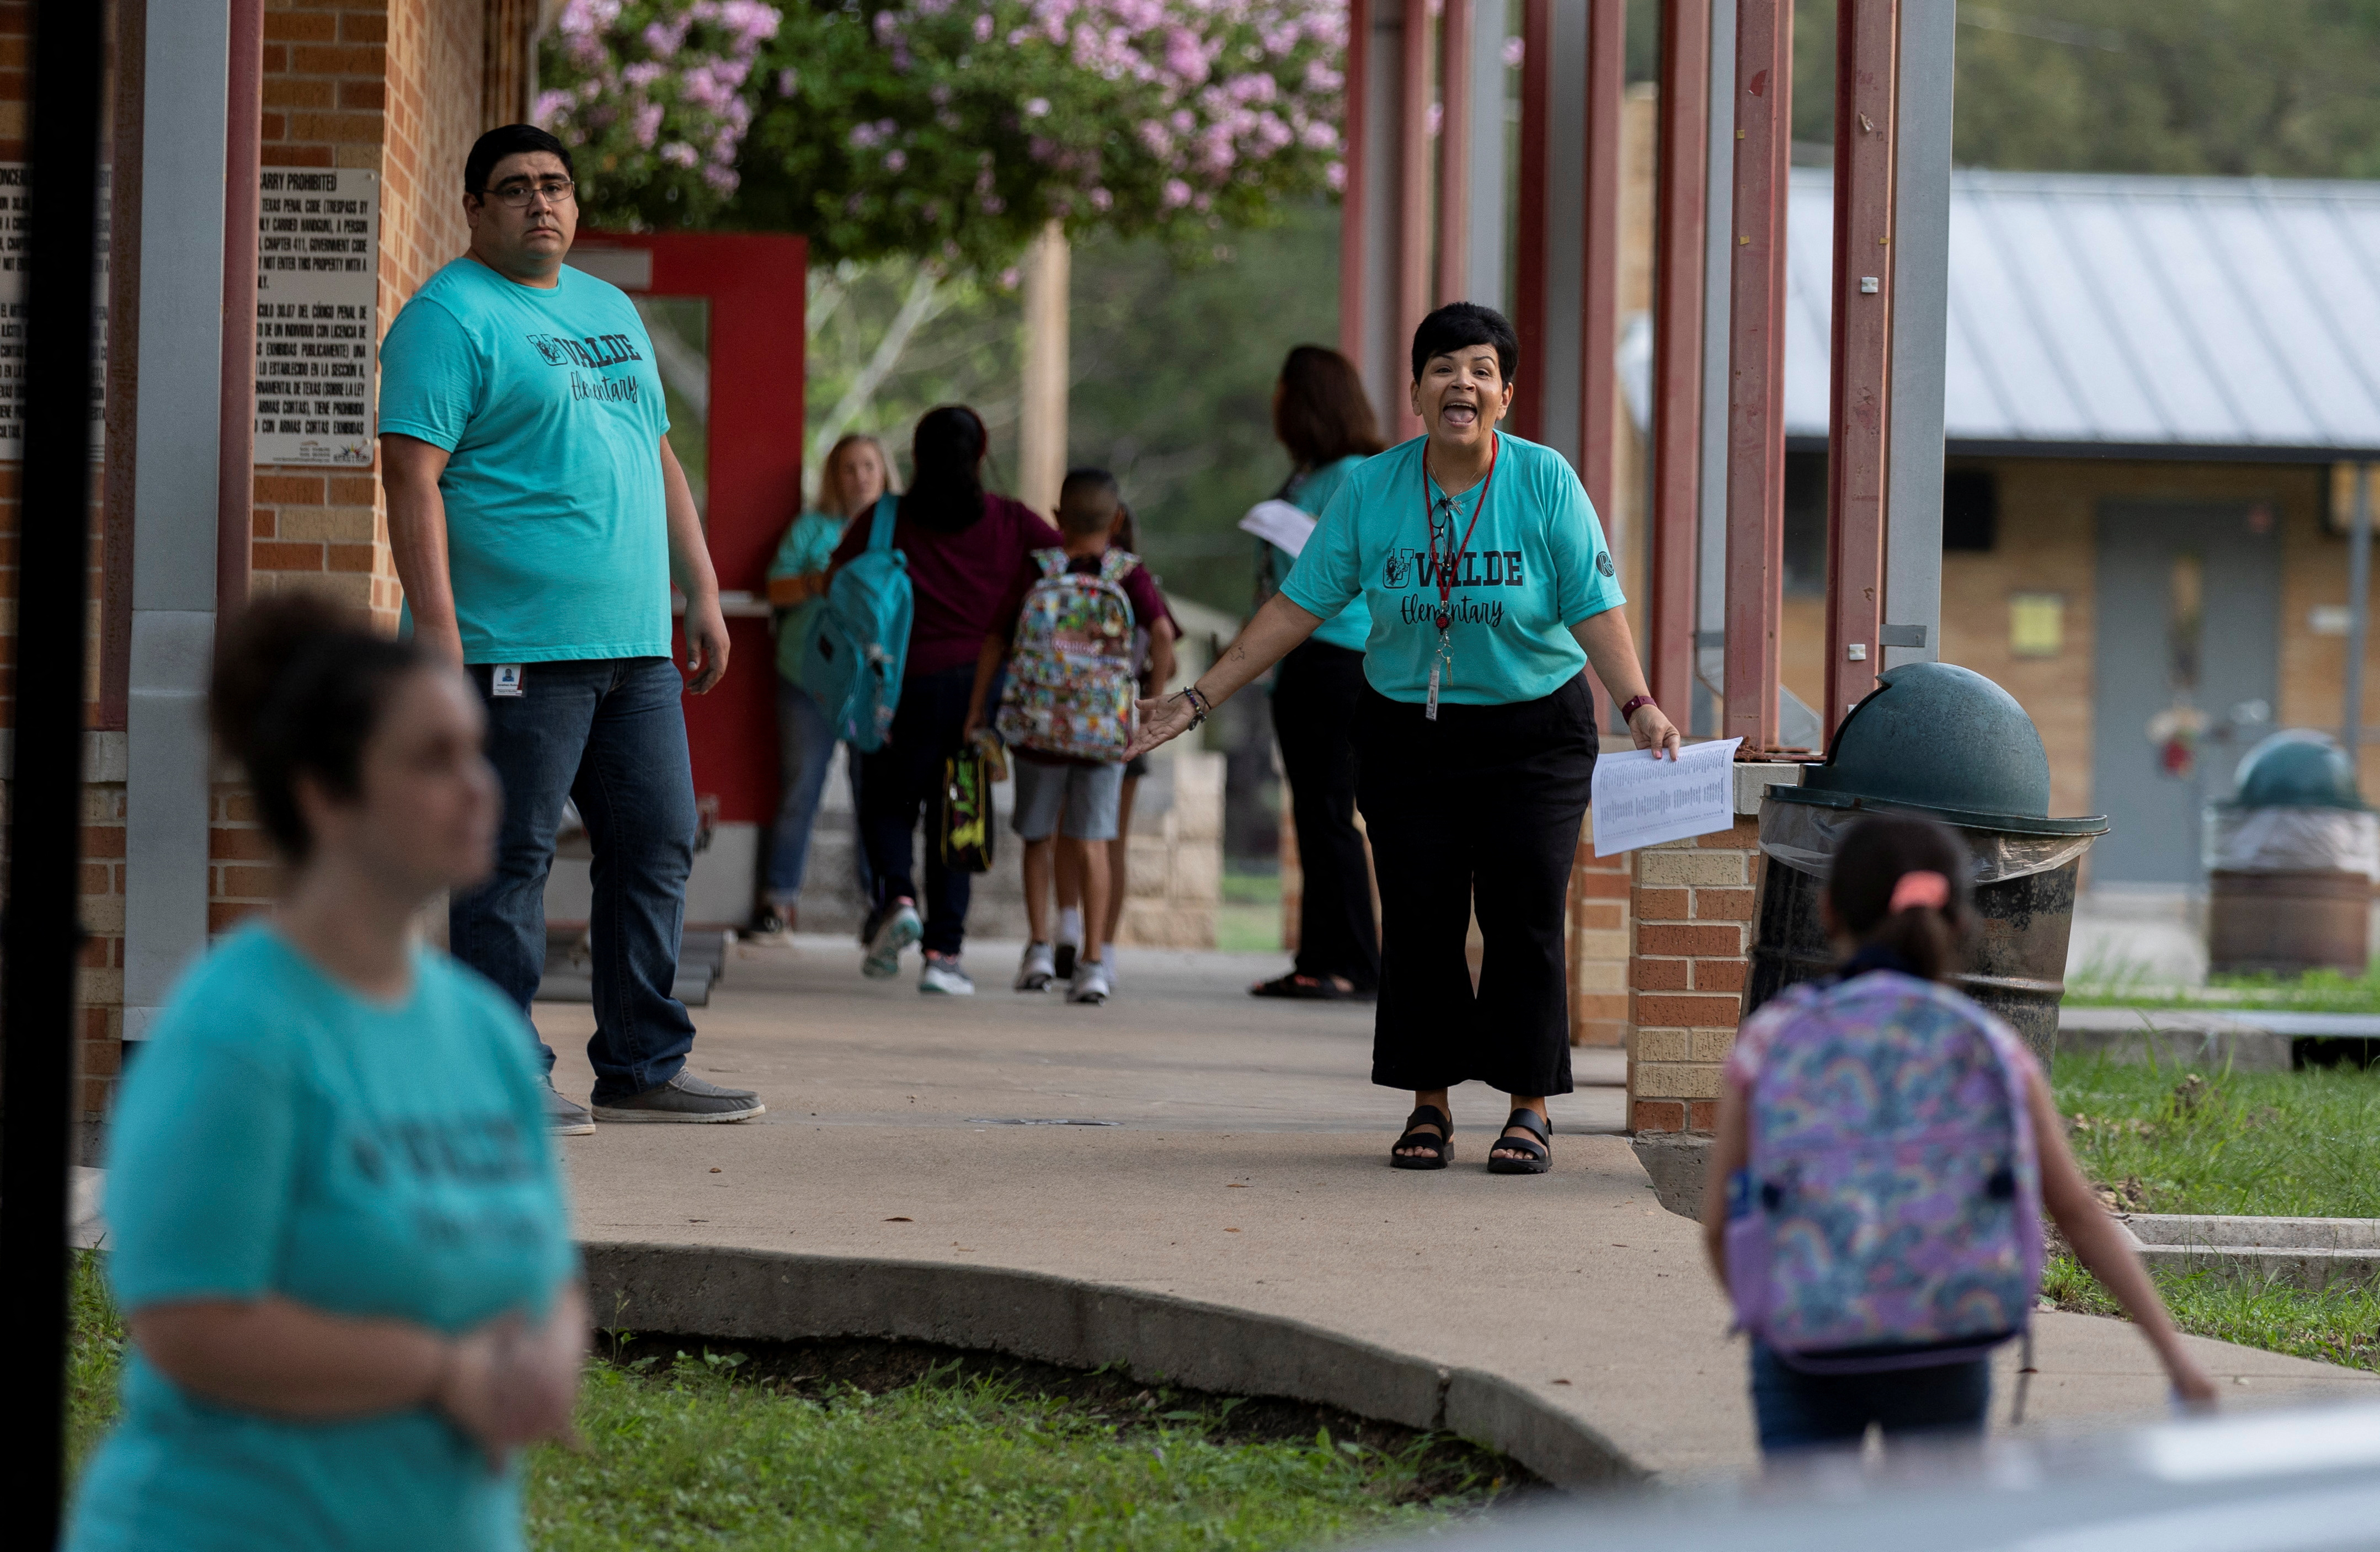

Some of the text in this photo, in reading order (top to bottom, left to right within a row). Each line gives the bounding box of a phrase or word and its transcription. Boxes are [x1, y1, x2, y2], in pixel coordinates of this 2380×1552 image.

[287, 173, 337, 191] PROHIBITED
[262, 198, 368, 215] TEXAS PENAL CODE (TRESPASS BY
[344, 220, 368, 233] PERSON
[264, 237, 291, 250] CHAPTER
[293, 237, 307, 253] 411,
[352, 239, 367, 253] CODE
[278, 256, 296, 270] ENTER
[313, 257, 344, 271] PROPERTY
[345, 258, 361, 271] WITH
[362, 258, 367, 271] A
[337, 305, 355, 319] PENAL
[360, 306, 366, 319] DE
[316, 324, 329, 338] CON
[331, 325, 356, 338] LICENCIA
[354, 344, 366, 358] UNA
[526, 334, 643, 368] UVALDE
[259, 361, 267, 376] LO
[269, 362, 308, 376] ESTABLECIDO
[311, 362, 319, 377] EN
[321, 363, 329, 377] LA
[294, 381, 301, 395] DE
[303, 381, 321, 396] TEXAS
[345, 382, 353, 396] LA
[355, 382, 365, 397] LEY
[570, 370, 638, 404] Elementary
[258, 399, 280, 413] ARMAS
[314, 401, 329, 415] TIENE
[262, 419, 275, 434] CON
[279, 420, 301, 434] ARMAS
[305, 420, 329, 434] CORTAS
